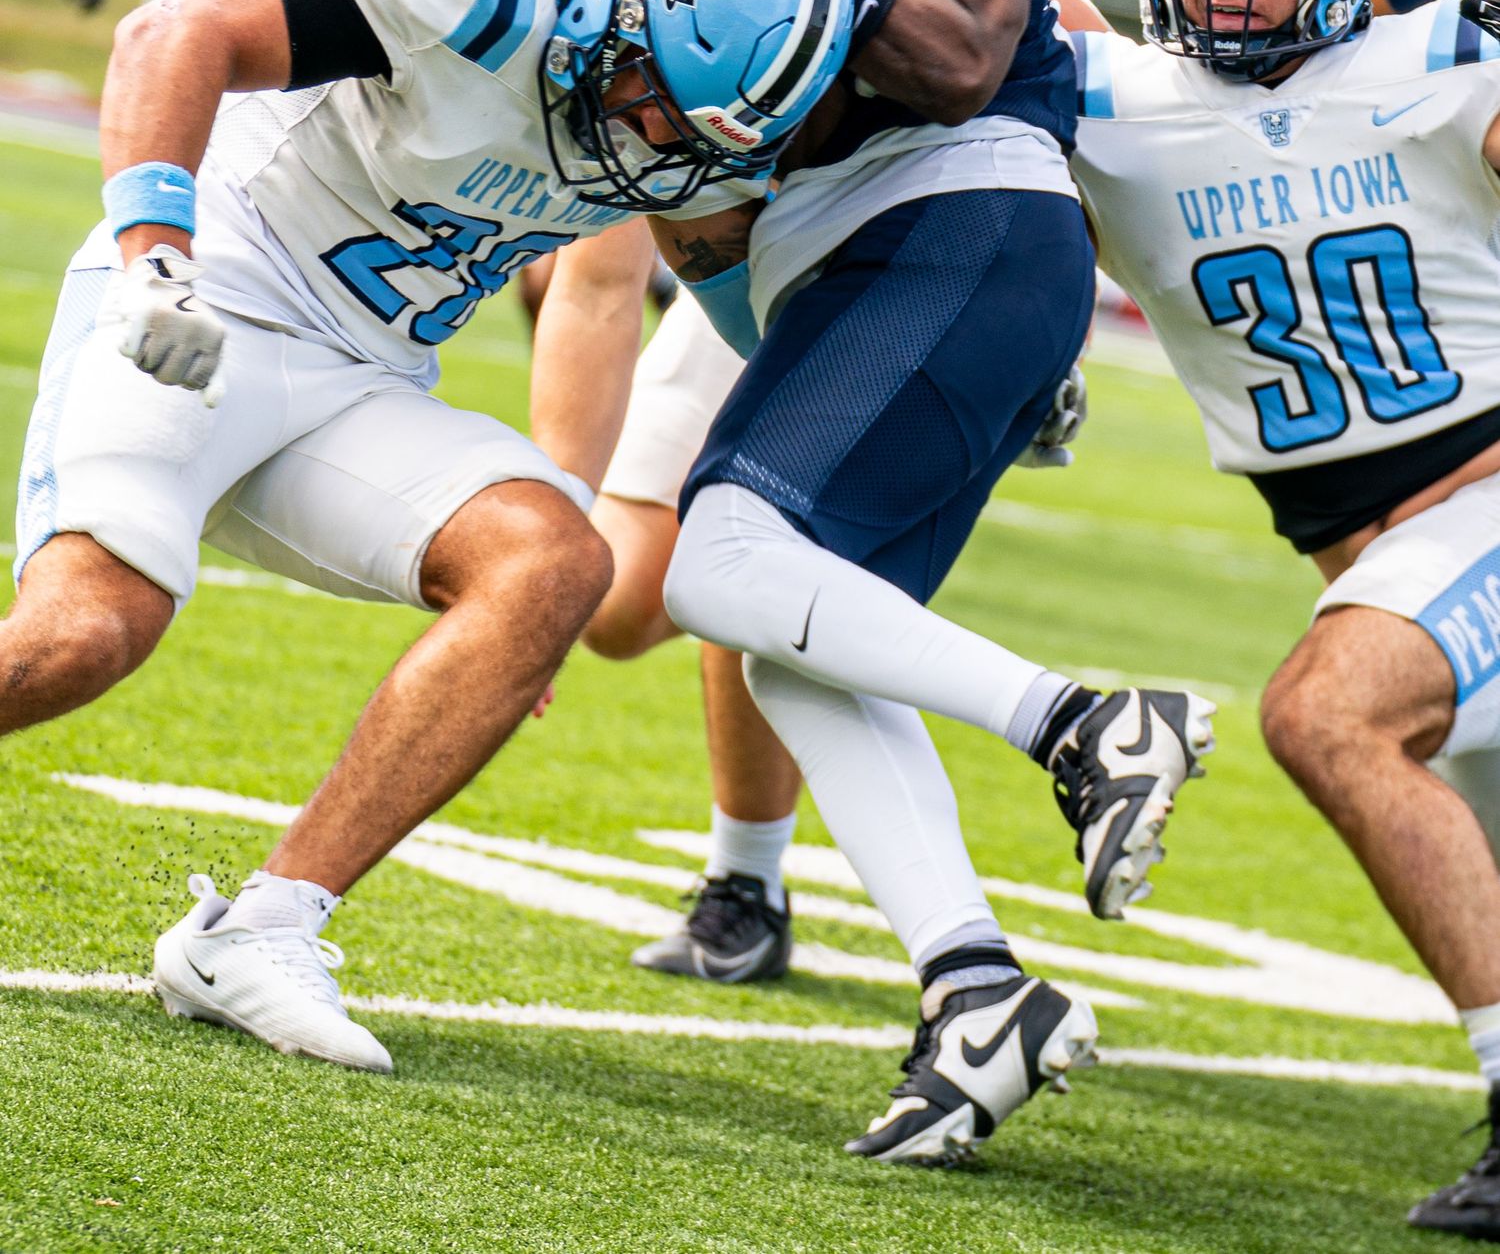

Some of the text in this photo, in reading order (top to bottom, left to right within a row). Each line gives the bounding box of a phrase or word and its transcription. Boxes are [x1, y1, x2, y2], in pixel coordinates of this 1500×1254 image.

[706, 115, 762, 148] Riddell
[456, 158, 553, 220] UPPER
[1176, 152, 1410, 240] UPPER IOWA
[1191, 222, 1464, 454] 30
